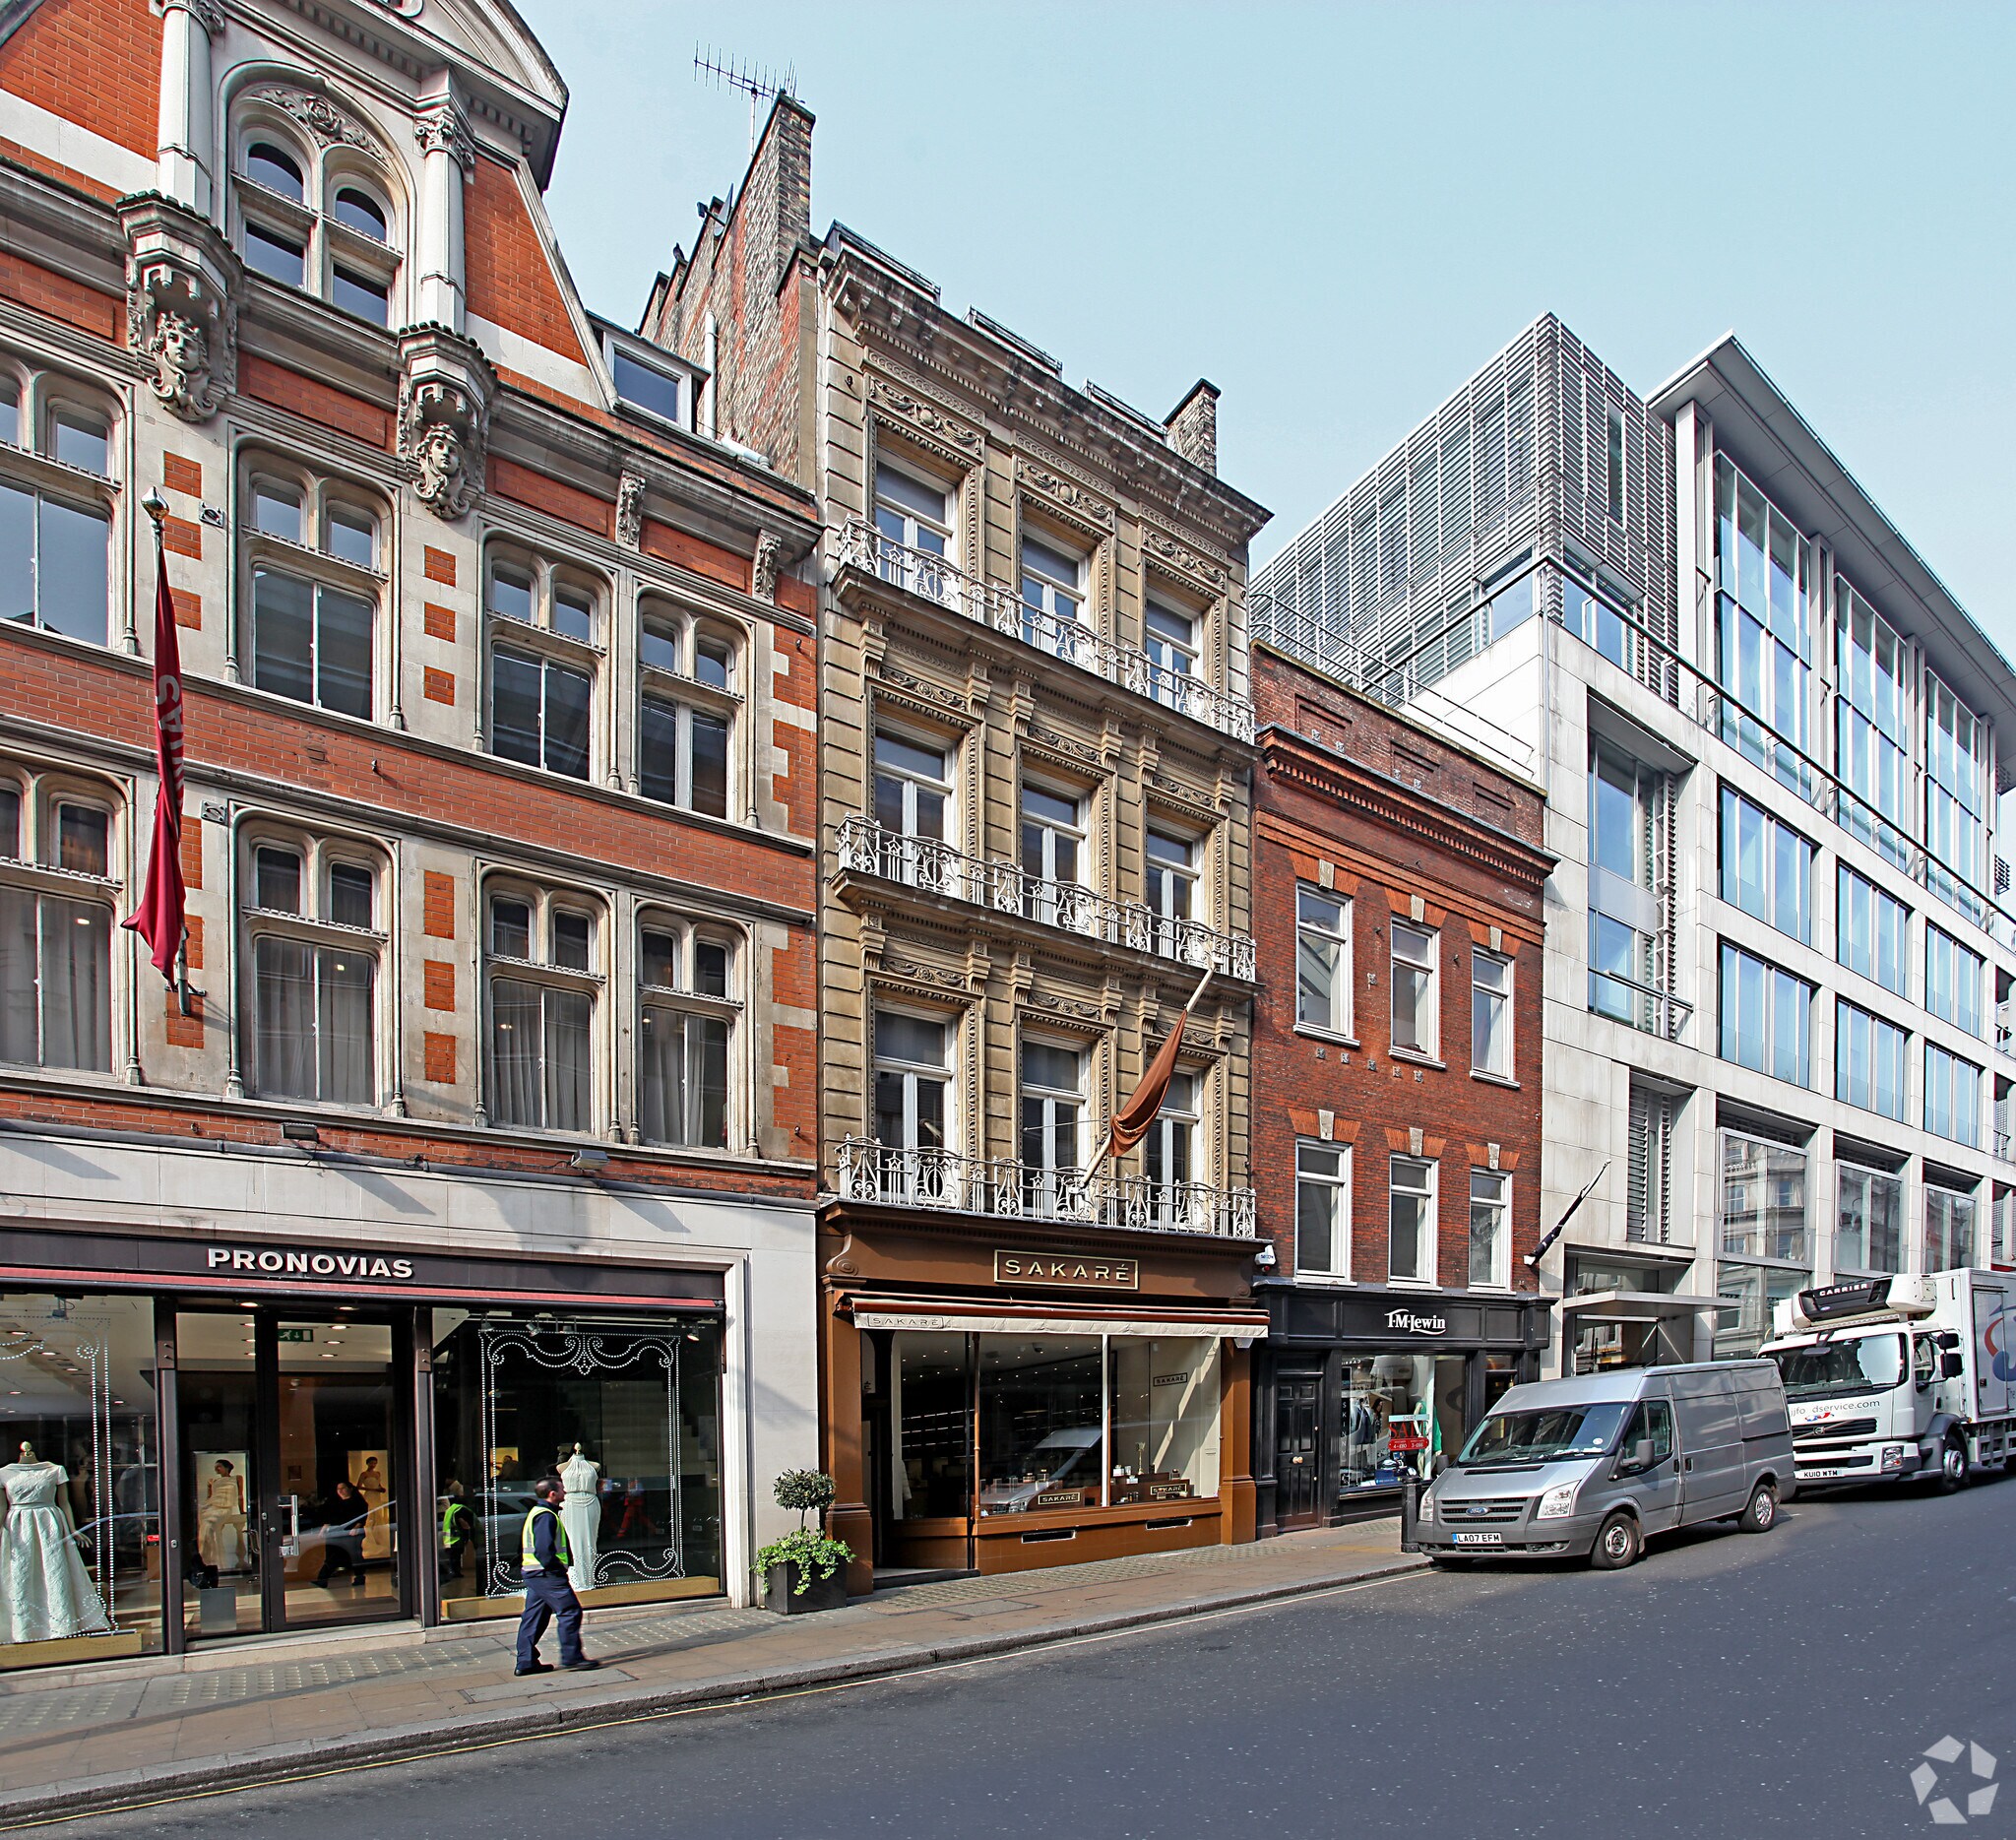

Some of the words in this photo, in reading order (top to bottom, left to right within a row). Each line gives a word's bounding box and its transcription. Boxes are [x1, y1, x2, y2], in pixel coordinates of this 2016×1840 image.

[208, 1247, 413, 1279] PRONOVIAS
[1005, 1259, 1130, 1281] SAKARÉ
[1819, 1283, 1868, 1297] CARRIER
[873, 1317, 939, 1326] SAKARÉ
[1156, 1375, 1184, 1384] SAKARÉ
[1458, 1534, 1480, 1543] LA07
